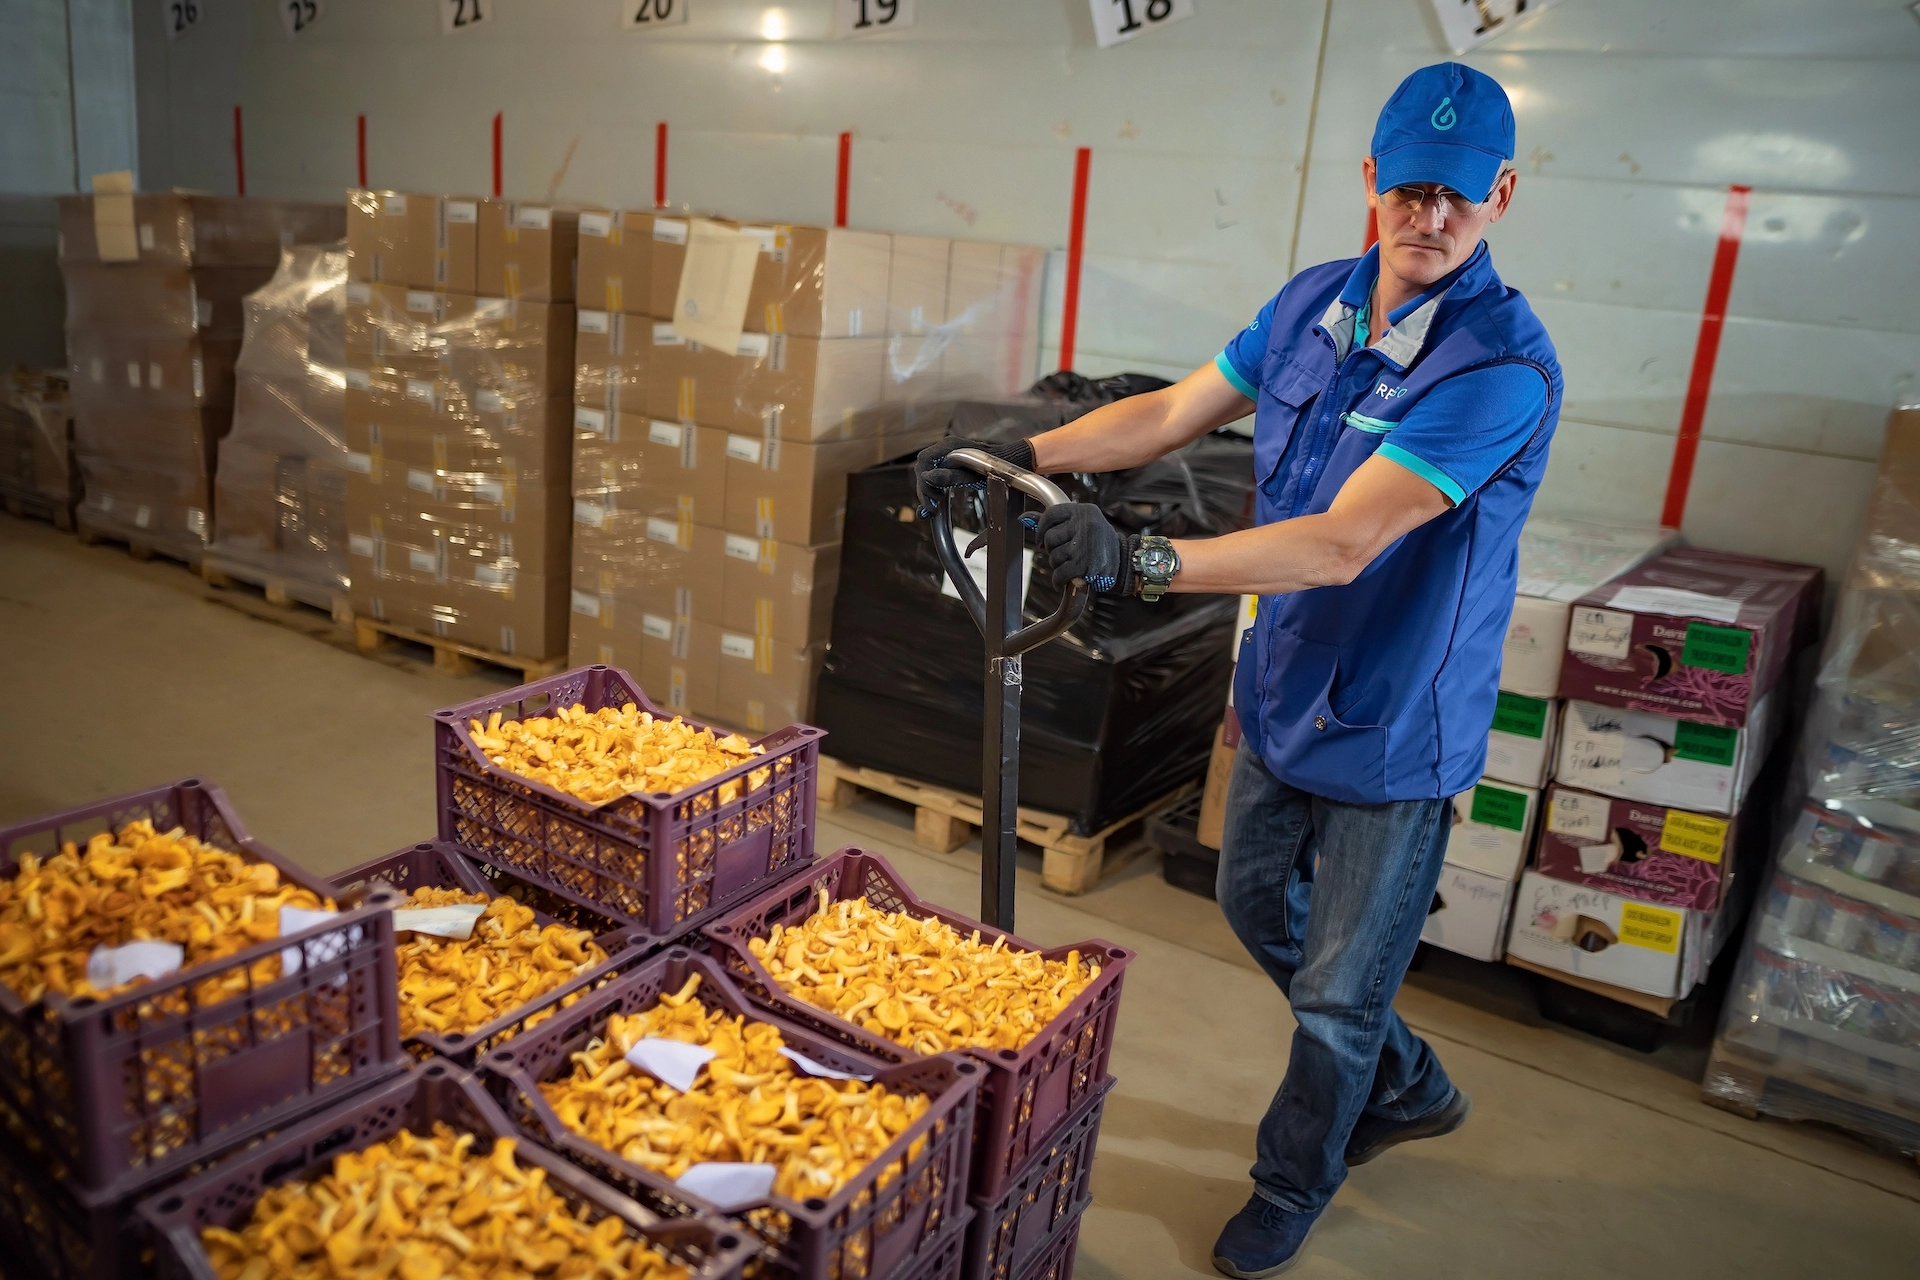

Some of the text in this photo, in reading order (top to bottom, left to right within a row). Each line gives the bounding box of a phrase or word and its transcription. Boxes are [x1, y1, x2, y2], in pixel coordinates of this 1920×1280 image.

[171, 0, 198, 31] 26
[288, 0, 317, 31] 25
[450, 0, 483, 28] 21
[634, 0, 673, 23] 20
[853, 0, 898, 29] 19
